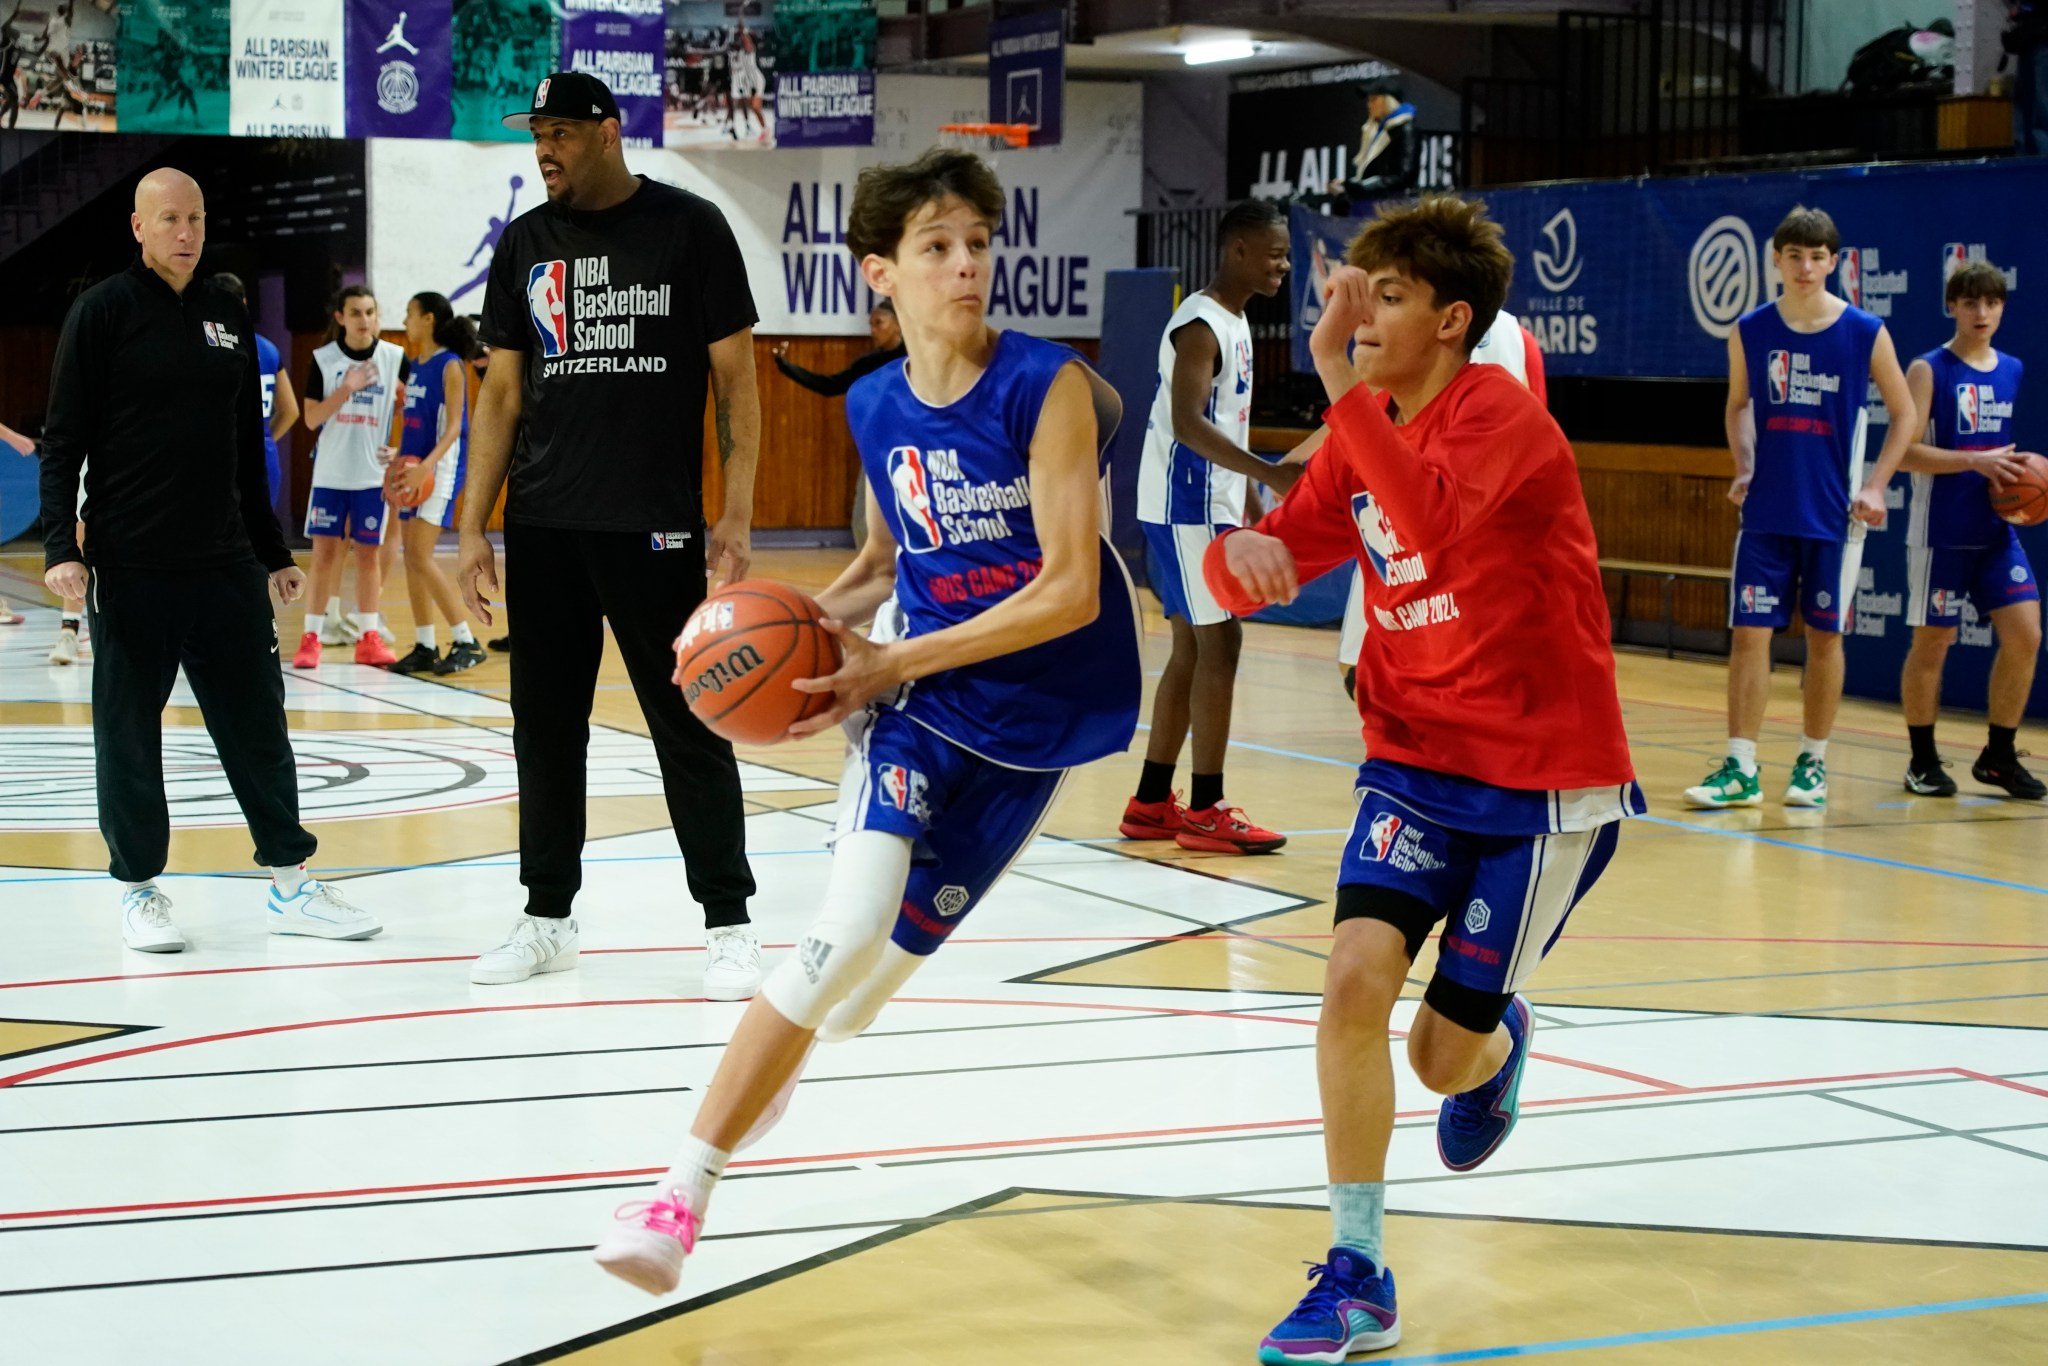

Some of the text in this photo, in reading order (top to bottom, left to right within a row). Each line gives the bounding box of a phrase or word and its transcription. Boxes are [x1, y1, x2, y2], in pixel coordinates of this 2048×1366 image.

[244, 38, 329, 58] ALL PARISIAN
[571, 49, 654, 73] ALL PARISIAN
[235, 60, 338, 81] WINTER LEAGUE
[778, 76, 801, 96] ALL
[801, 75, 859, 95] PARISIAN
[778, 94, 873, 118] WINTER LEAGUE
[783, 182, 847, 245] ALL
[574, 256, 610, 288] NBA
[984, 255, 1089, 317] AGUE
[573, 283, 671, 320] Basketball
[1528, 296, 1585, 312] VILLE DE
[574, 317, 635, 352] School
[927, 449, 966, 481] NBA
[941, 511, 1013, 545] School
[1396, 598, 1429, 631] CAMP
[1429, 592, 1460, 625] 2024
